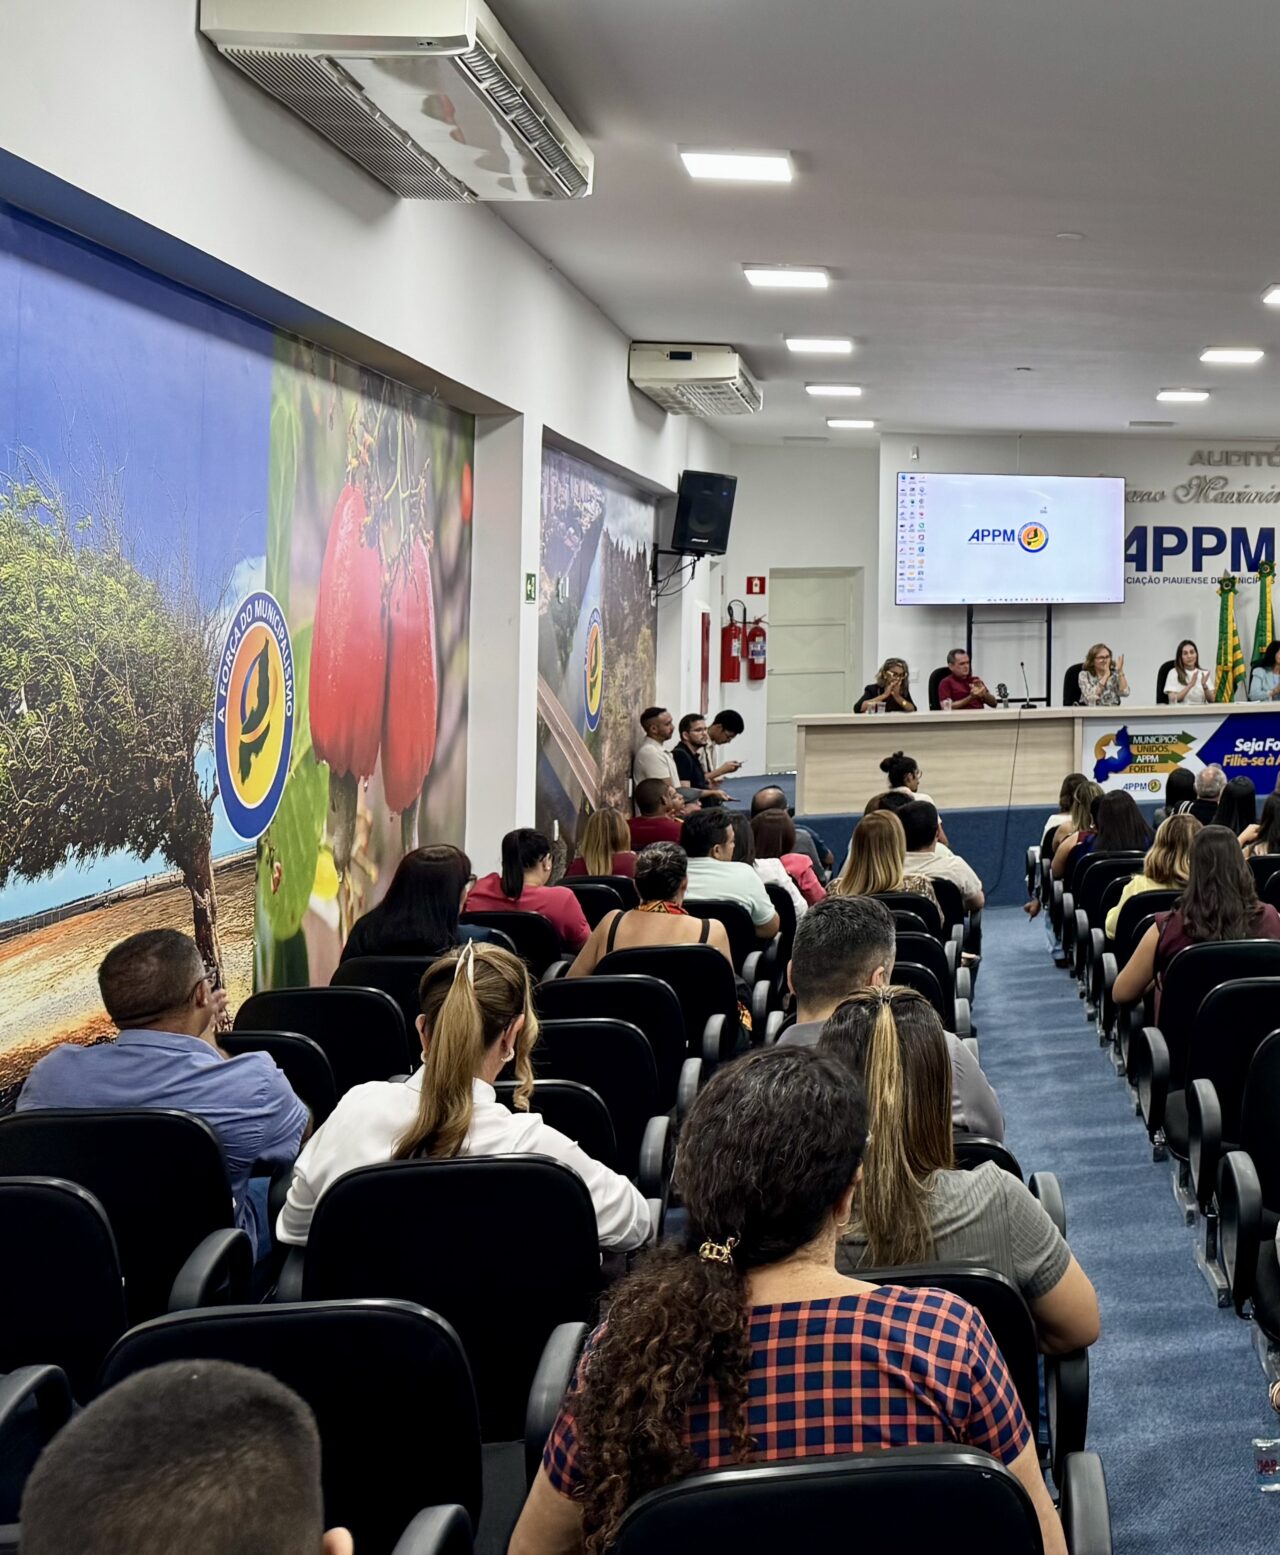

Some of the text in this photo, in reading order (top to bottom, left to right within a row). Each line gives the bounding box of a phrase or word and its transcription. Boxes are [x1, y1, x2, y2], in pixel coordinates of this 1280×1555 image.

[968, 529, 1015, 542] APPM
[1124, 525, 1276, 573] APPM
[1125, 575, 1161, 586] CIAÇÃO
[1162, 576, 1208, 585] PIAUIENSE
[217, 598, 293, 723] A FORÇA DO MUNICIPALISMO
[1234, 737, 1264, 755] Seja
[1136, 754, 1159, 763] APPM
[1222, 753, 1265, 766] Filie-se
[1265, 753, 1275, 766] à
[1123, 782, 1147, 790] APPM
